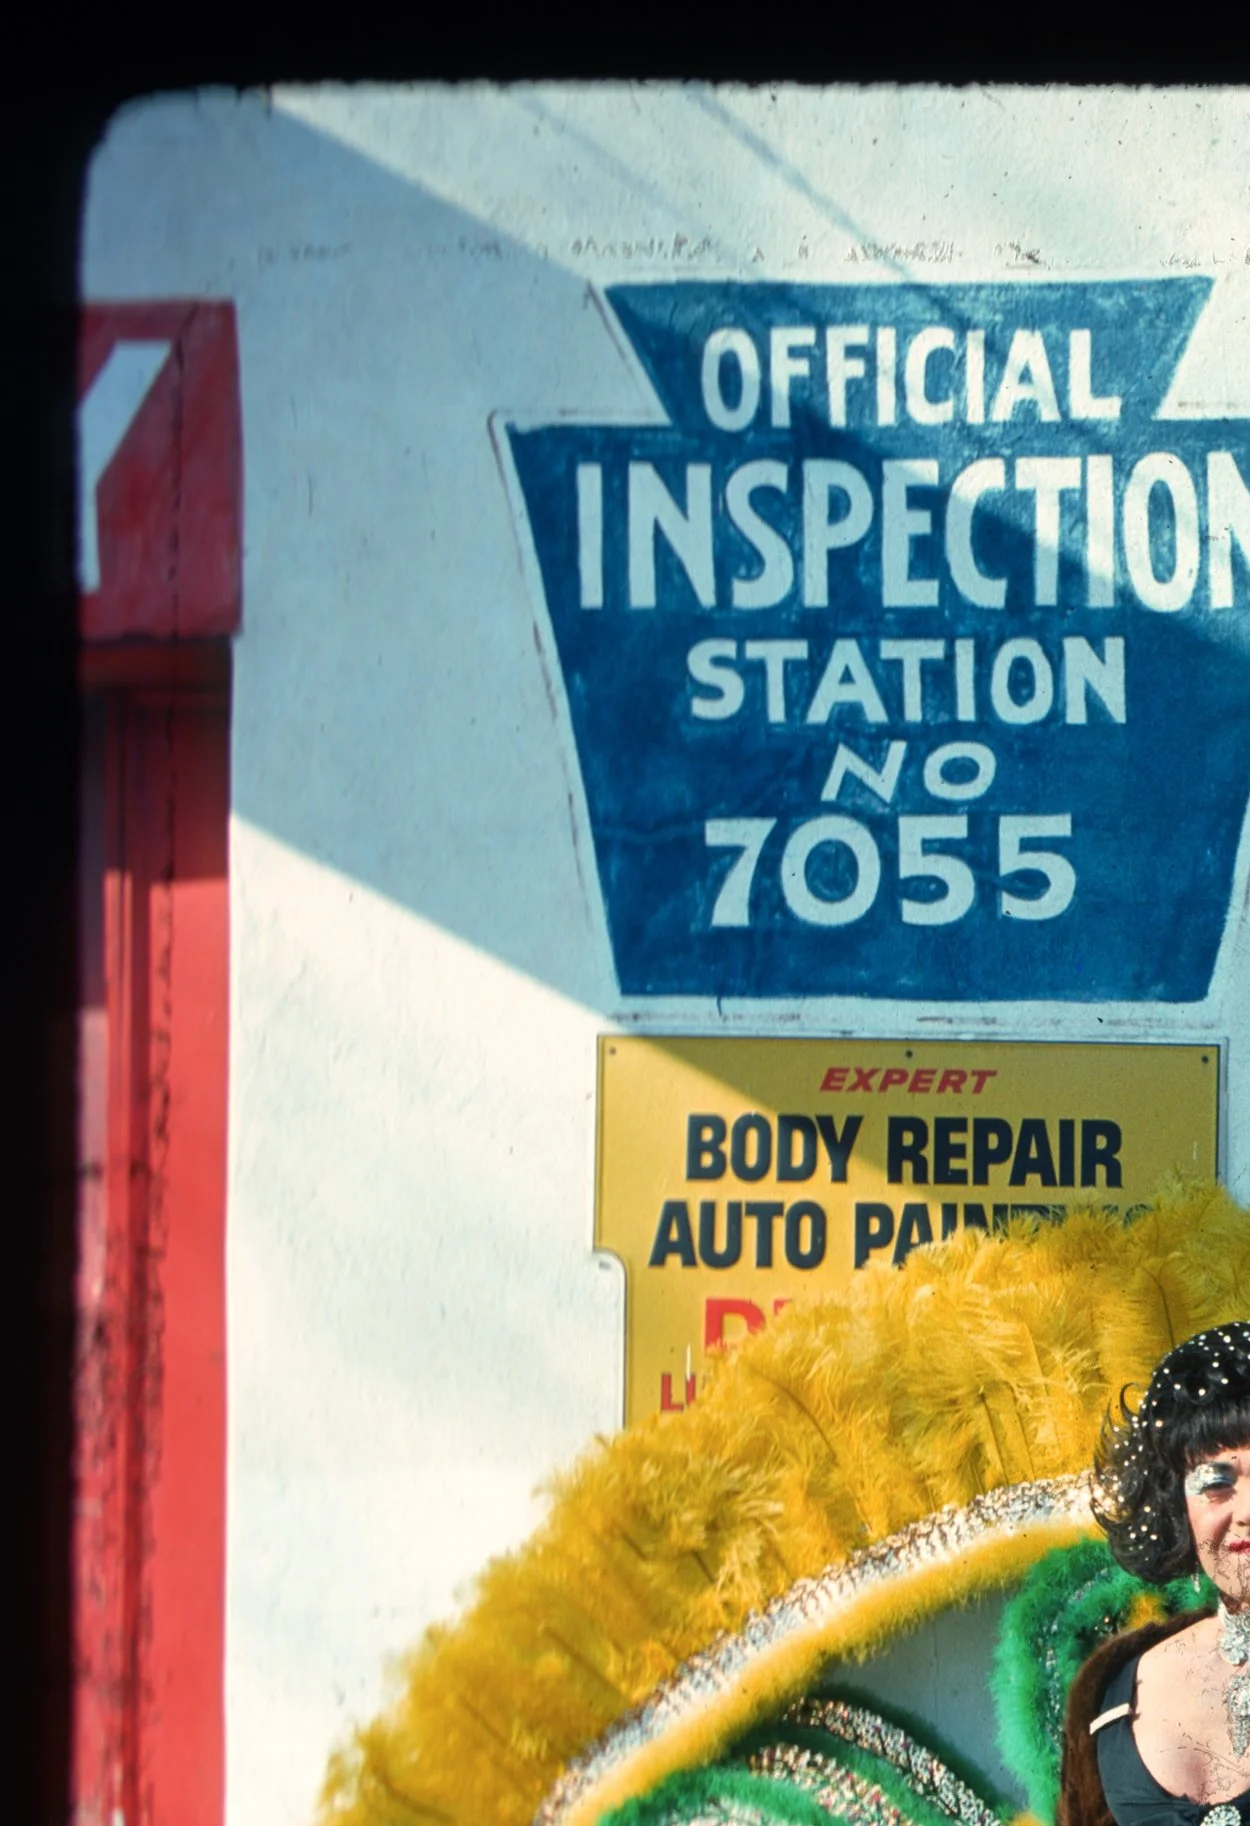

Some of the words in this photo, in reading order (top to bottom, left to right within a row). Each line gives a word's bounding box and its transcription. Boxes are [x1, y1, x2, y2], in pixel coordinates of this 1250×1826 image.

[699, 325, 1123, 432] OFFICIAL
[686, 635, 1128, 726] STATION
[821, 739, 998, 806] NO
[702, 812, 1077, 928] 7055
[819, 1066, 997, 1096] EXPERT
[685, 1112, 864, 1183] BODY
[885, 1114, 1124, 1189] REPAIR
[647, 1199, 829, 1270] AUTO
